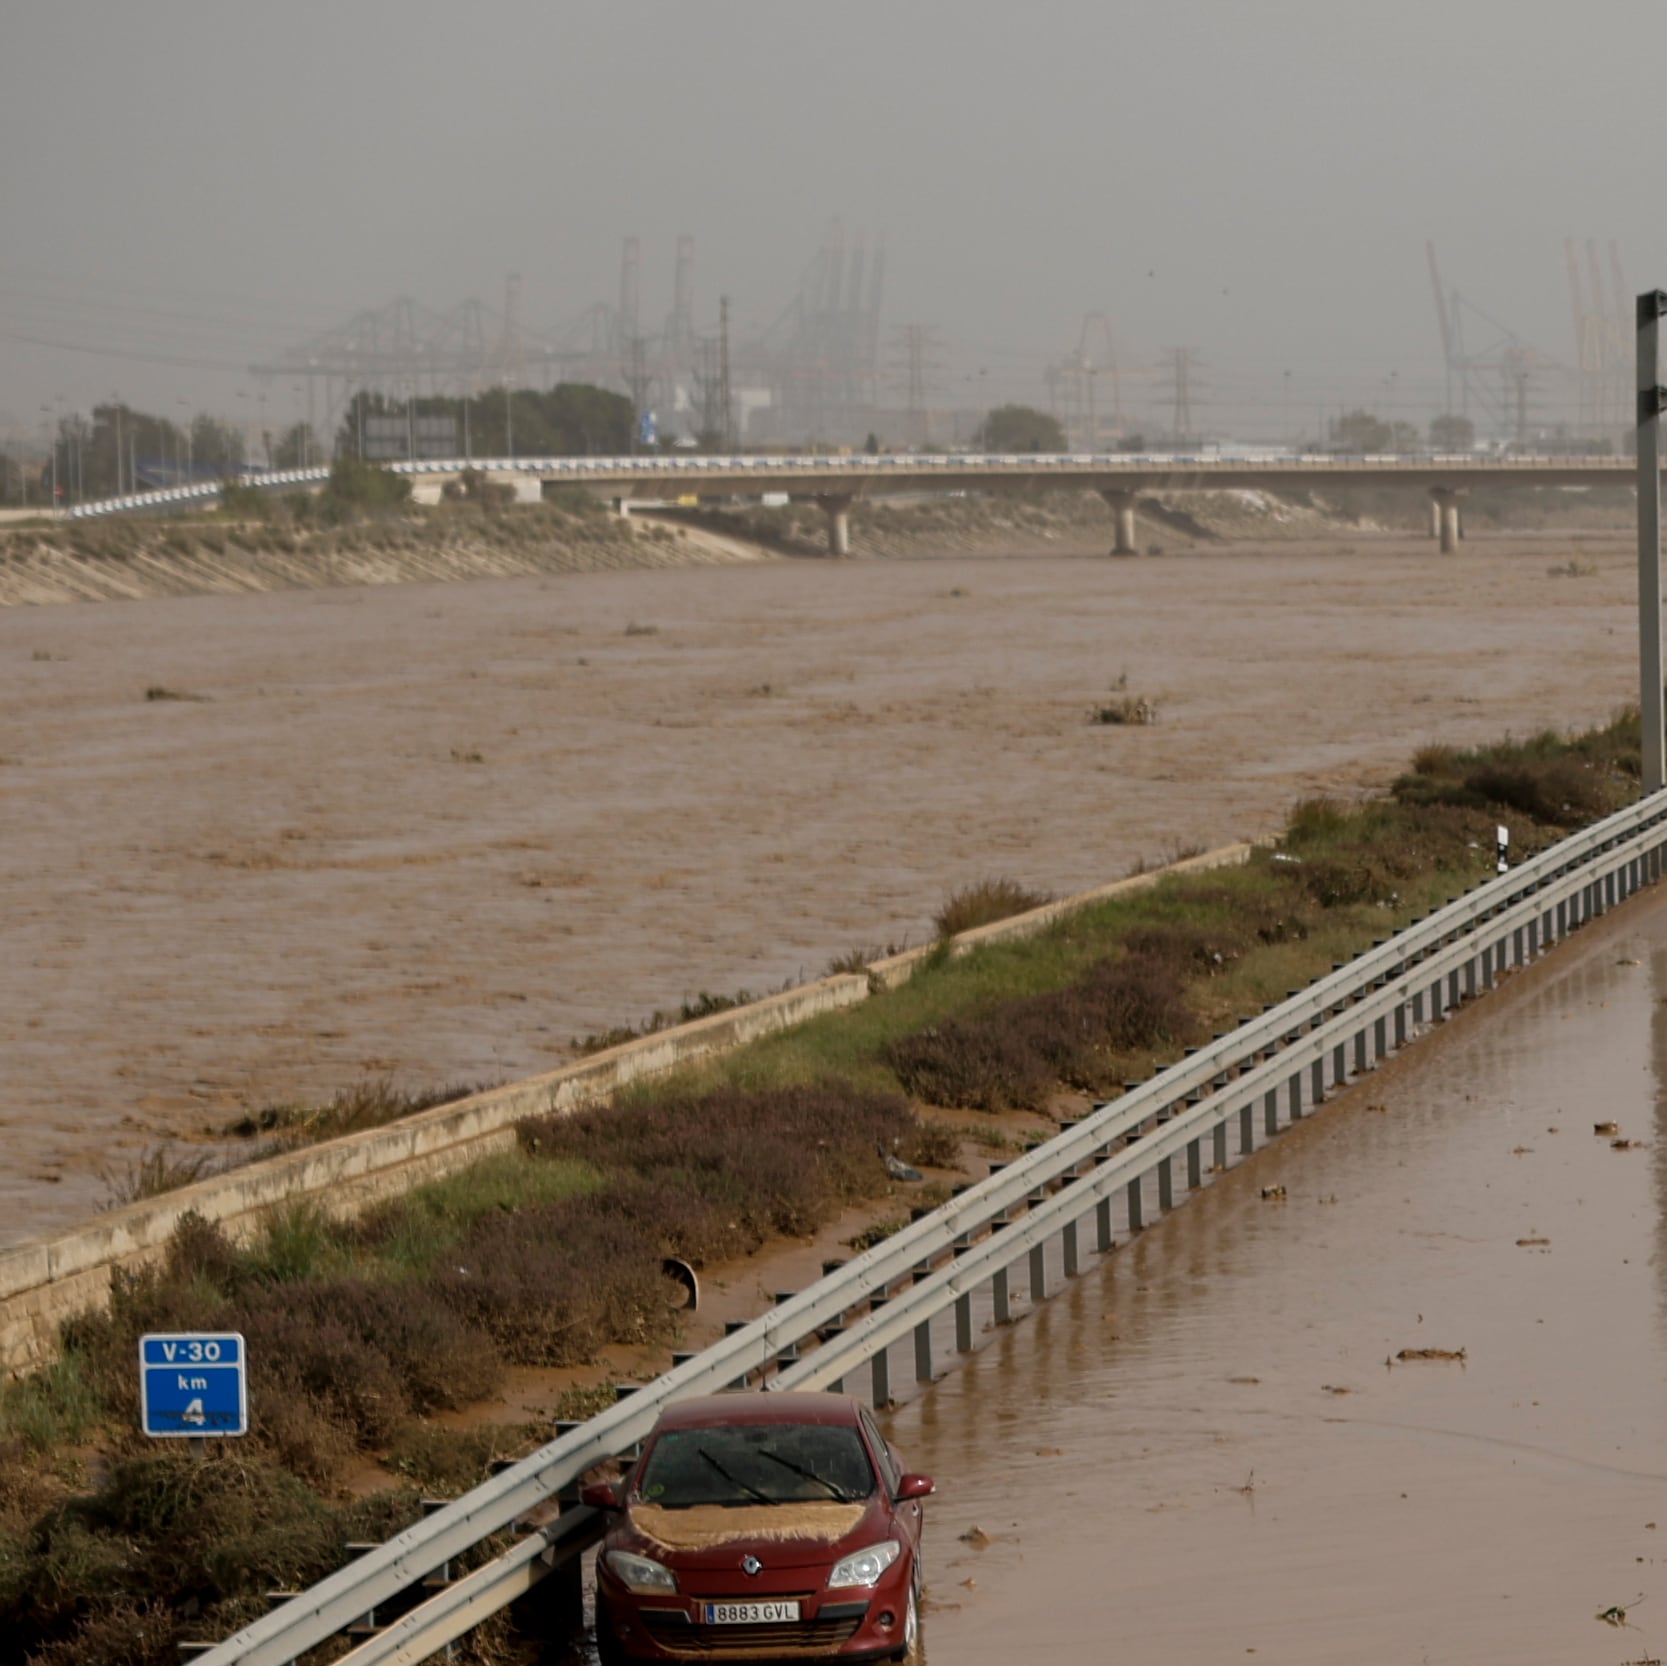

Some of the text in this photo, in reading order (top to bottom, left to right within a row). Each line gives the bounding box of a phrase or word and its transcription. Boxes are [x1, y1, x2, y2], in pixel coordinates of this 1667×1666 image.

[162, 1342, 221, 1362] V-30
[178, 1374, 208, 1390] km
[183, 1398, 206, 1426] 4
[718, 1604, 795, 1622] 8883 GVL
